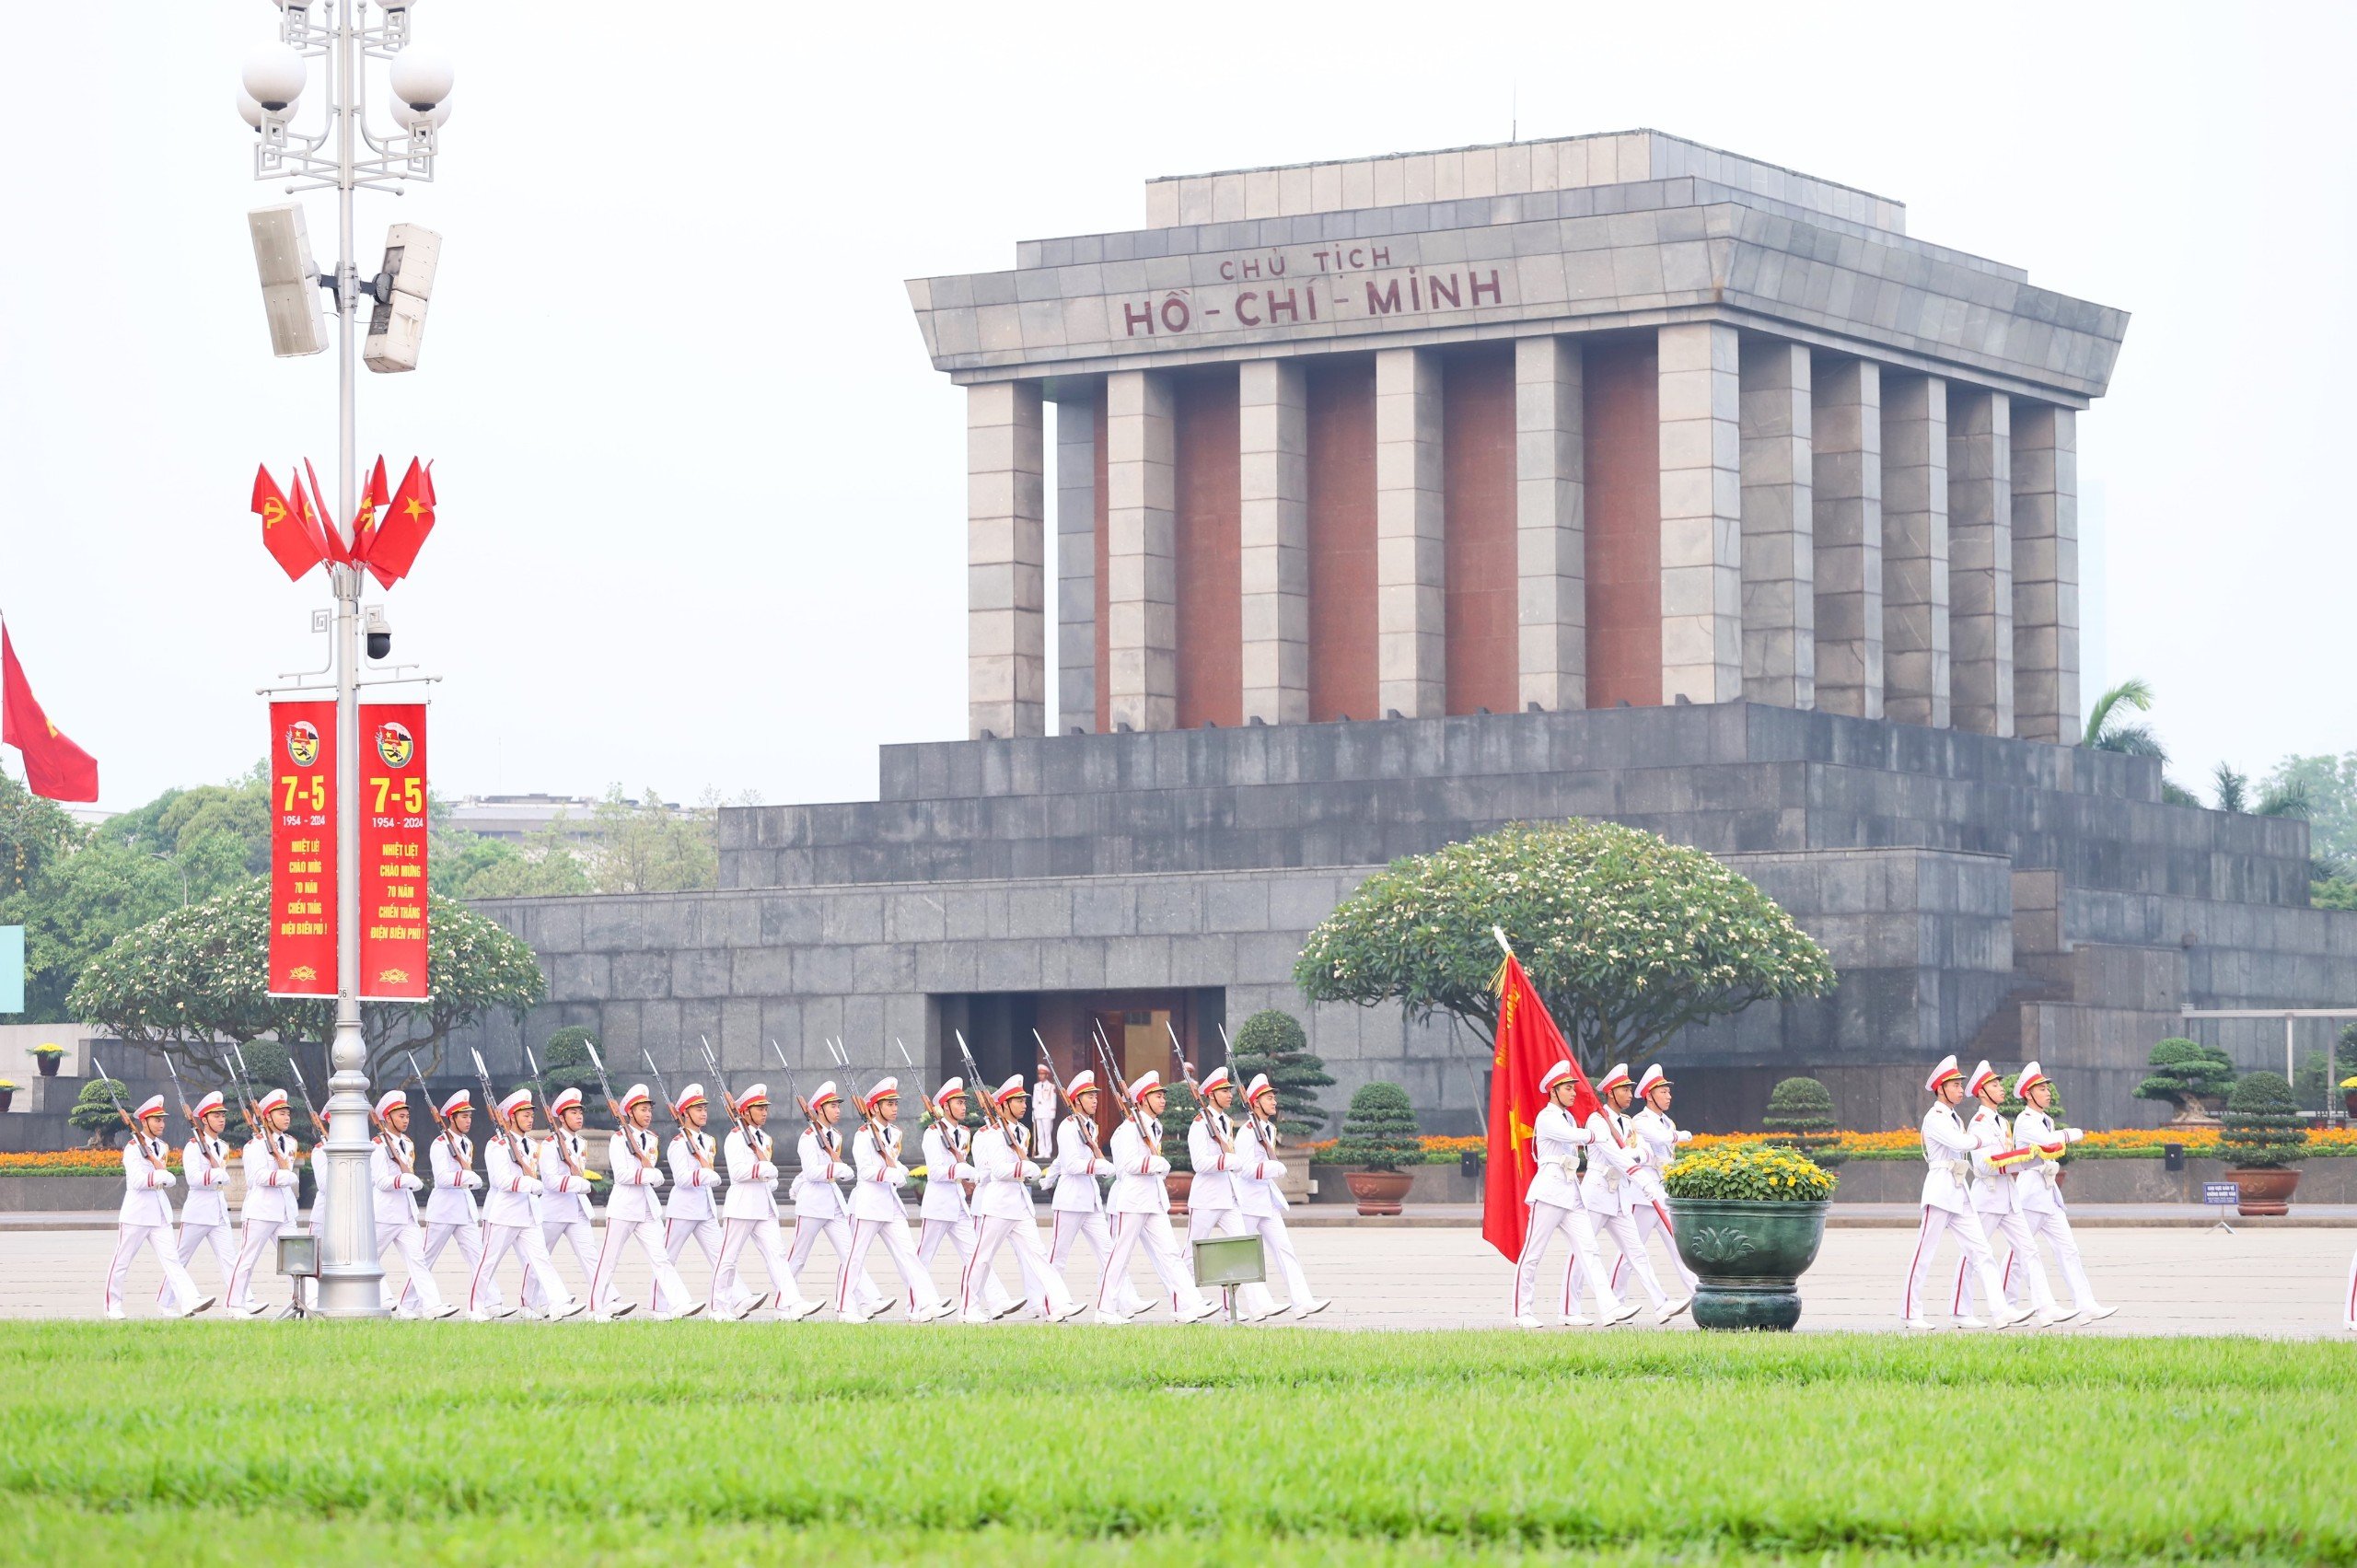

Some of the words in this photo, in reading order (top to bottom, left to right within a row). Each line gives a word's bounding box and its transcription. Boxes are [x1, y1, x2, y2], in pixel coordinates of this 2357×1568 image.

[1220, 248, 1285, 281] CHỦ
[1313, 243, 1390, 279] TỊCH
[281, 774, 325, 811] 7-5
[369, 777, 423, 814] 7-5
[283, 815, 301, 826] 1954
[372, 818, 394, 828] 1954
[403, 818, 424, 828] 2024
[382, 842, 403, 859] NHIỆT
[404, 842, 419, 859] LIỆT
[380, 862, 400, 877] CHÀO
[295, 881, 303, 894] 70
[387, 885, 397, 898] 70
[398, 883, 414, 898] NĂM
[378, 902, 399, 919] CHIẾN
